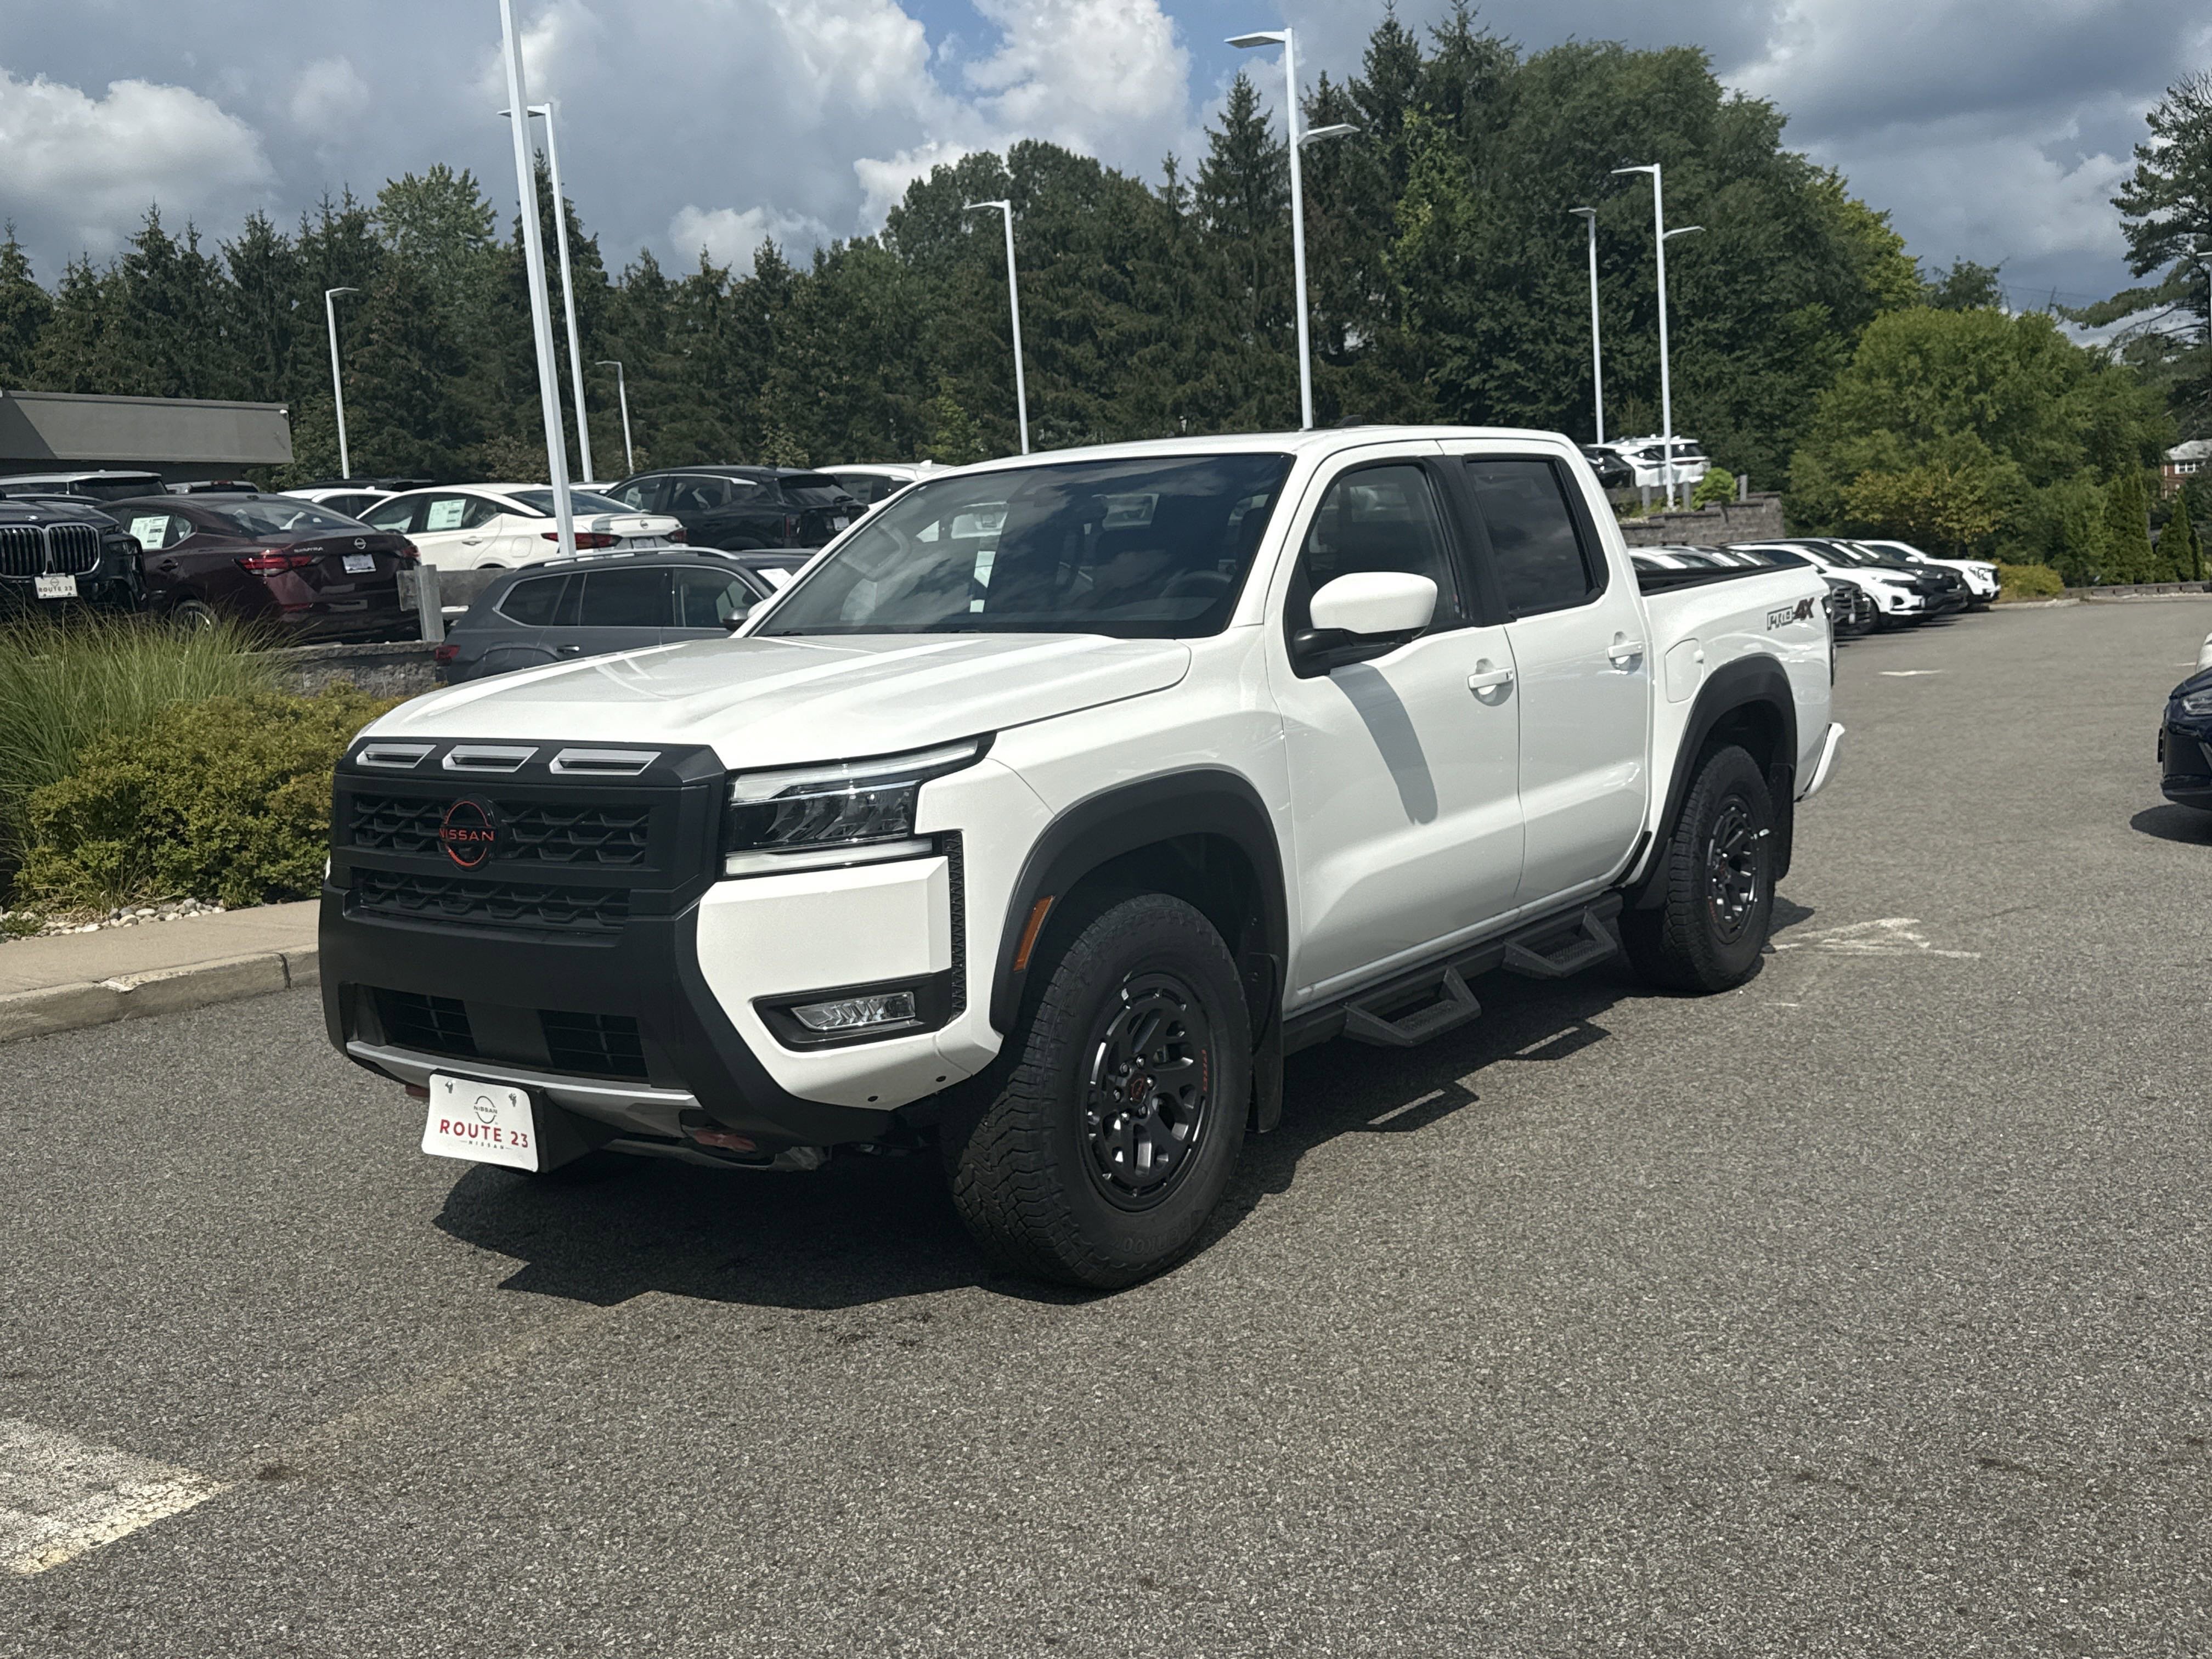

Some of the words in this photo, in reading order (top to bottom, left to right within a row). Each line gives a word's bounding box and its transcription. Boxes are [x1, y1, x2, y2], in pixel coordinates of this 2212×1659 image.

[439, 828, 494, 841] NISSAN
[473, 1105, 498, 1114] NISSAN
[439, 1119, 502, 1142] ROUTE
[510, 1131, 528, 1148] 23
[469, 1141, 504, 1149] NISSAN
